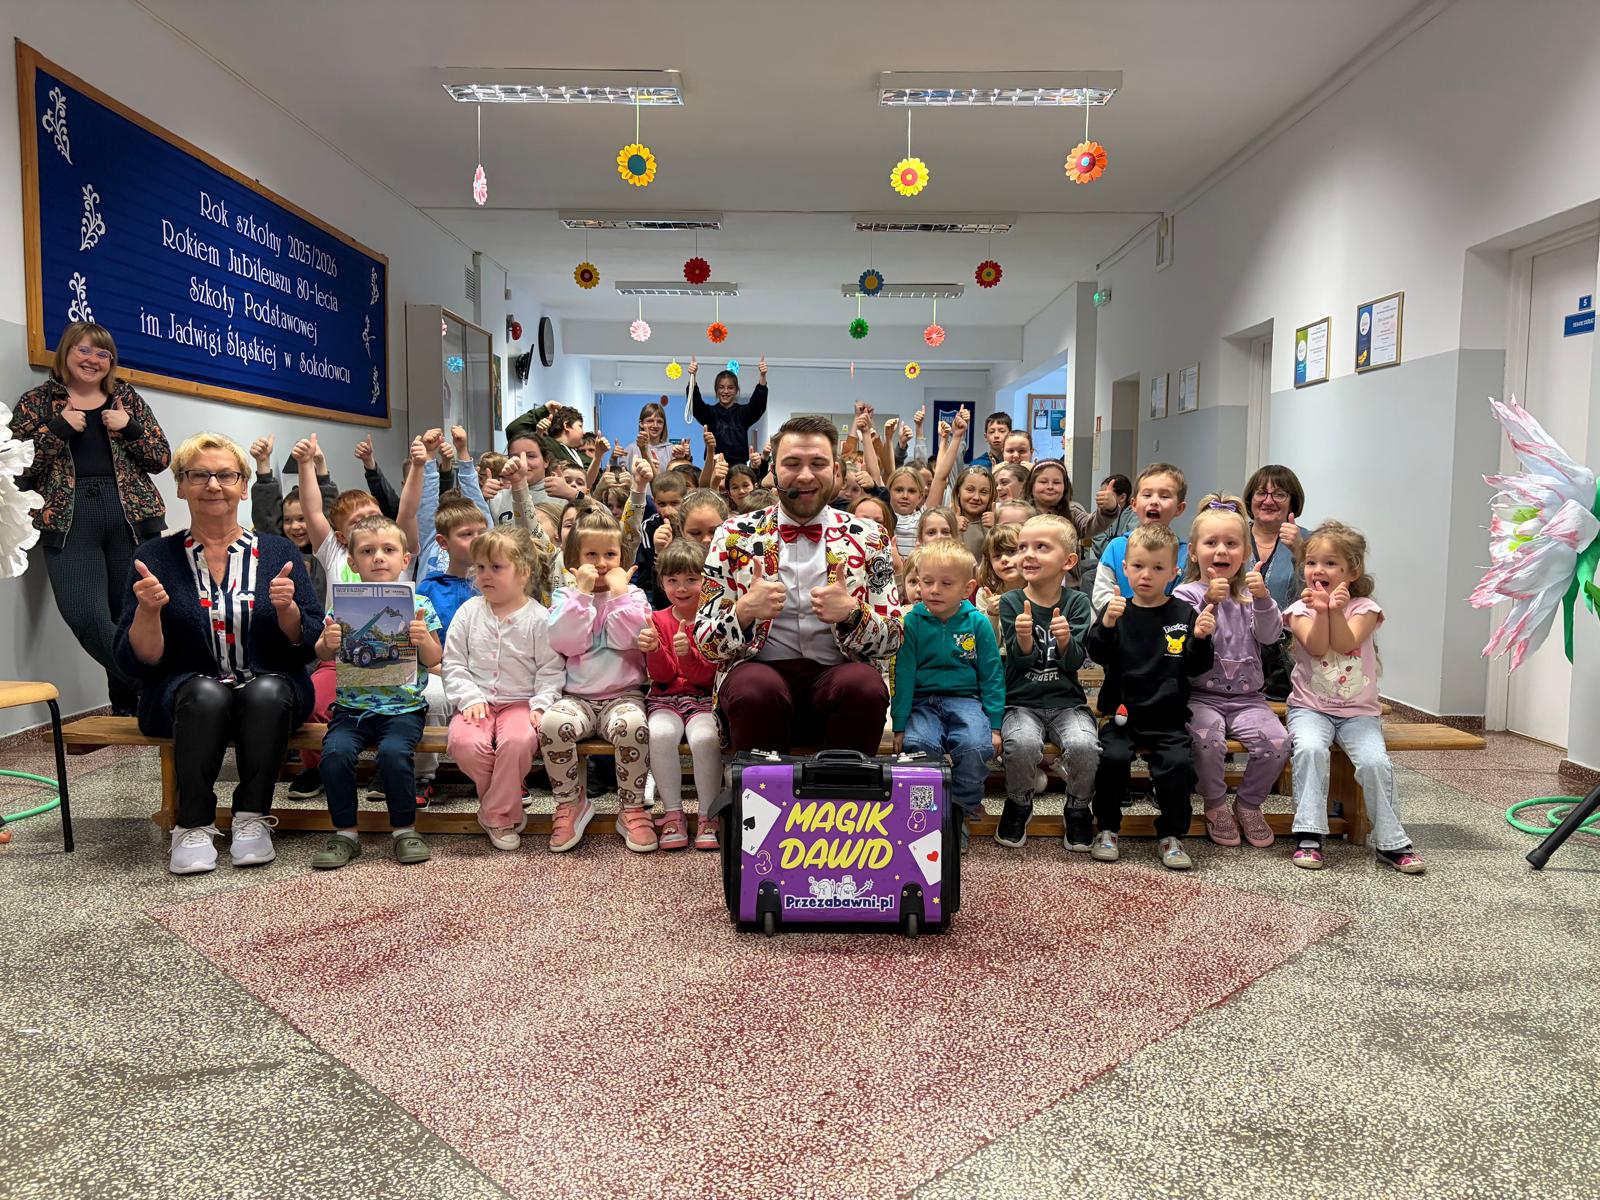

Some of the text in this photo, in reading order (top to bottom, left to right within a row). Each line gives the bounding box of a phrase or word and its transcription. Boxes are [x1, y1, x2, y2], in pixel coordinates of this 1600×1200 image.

[162, 219, 220, 267] Rokiem
[296, 277, 339, 312] 80-lecia
[200, 191, 338, 278] Rok szkolny 2025/2026
[140, 306, 351, 384] im. Jadwigi Śląskiej w Sokołowcu
[189, 276, 318, 346] Szkoły Podstawowej
[784, 801, 894, 836] MAGIK
[778, 838, 894, 870] DAWID
[785, 895, 894, 912] Przezabawni.pl
